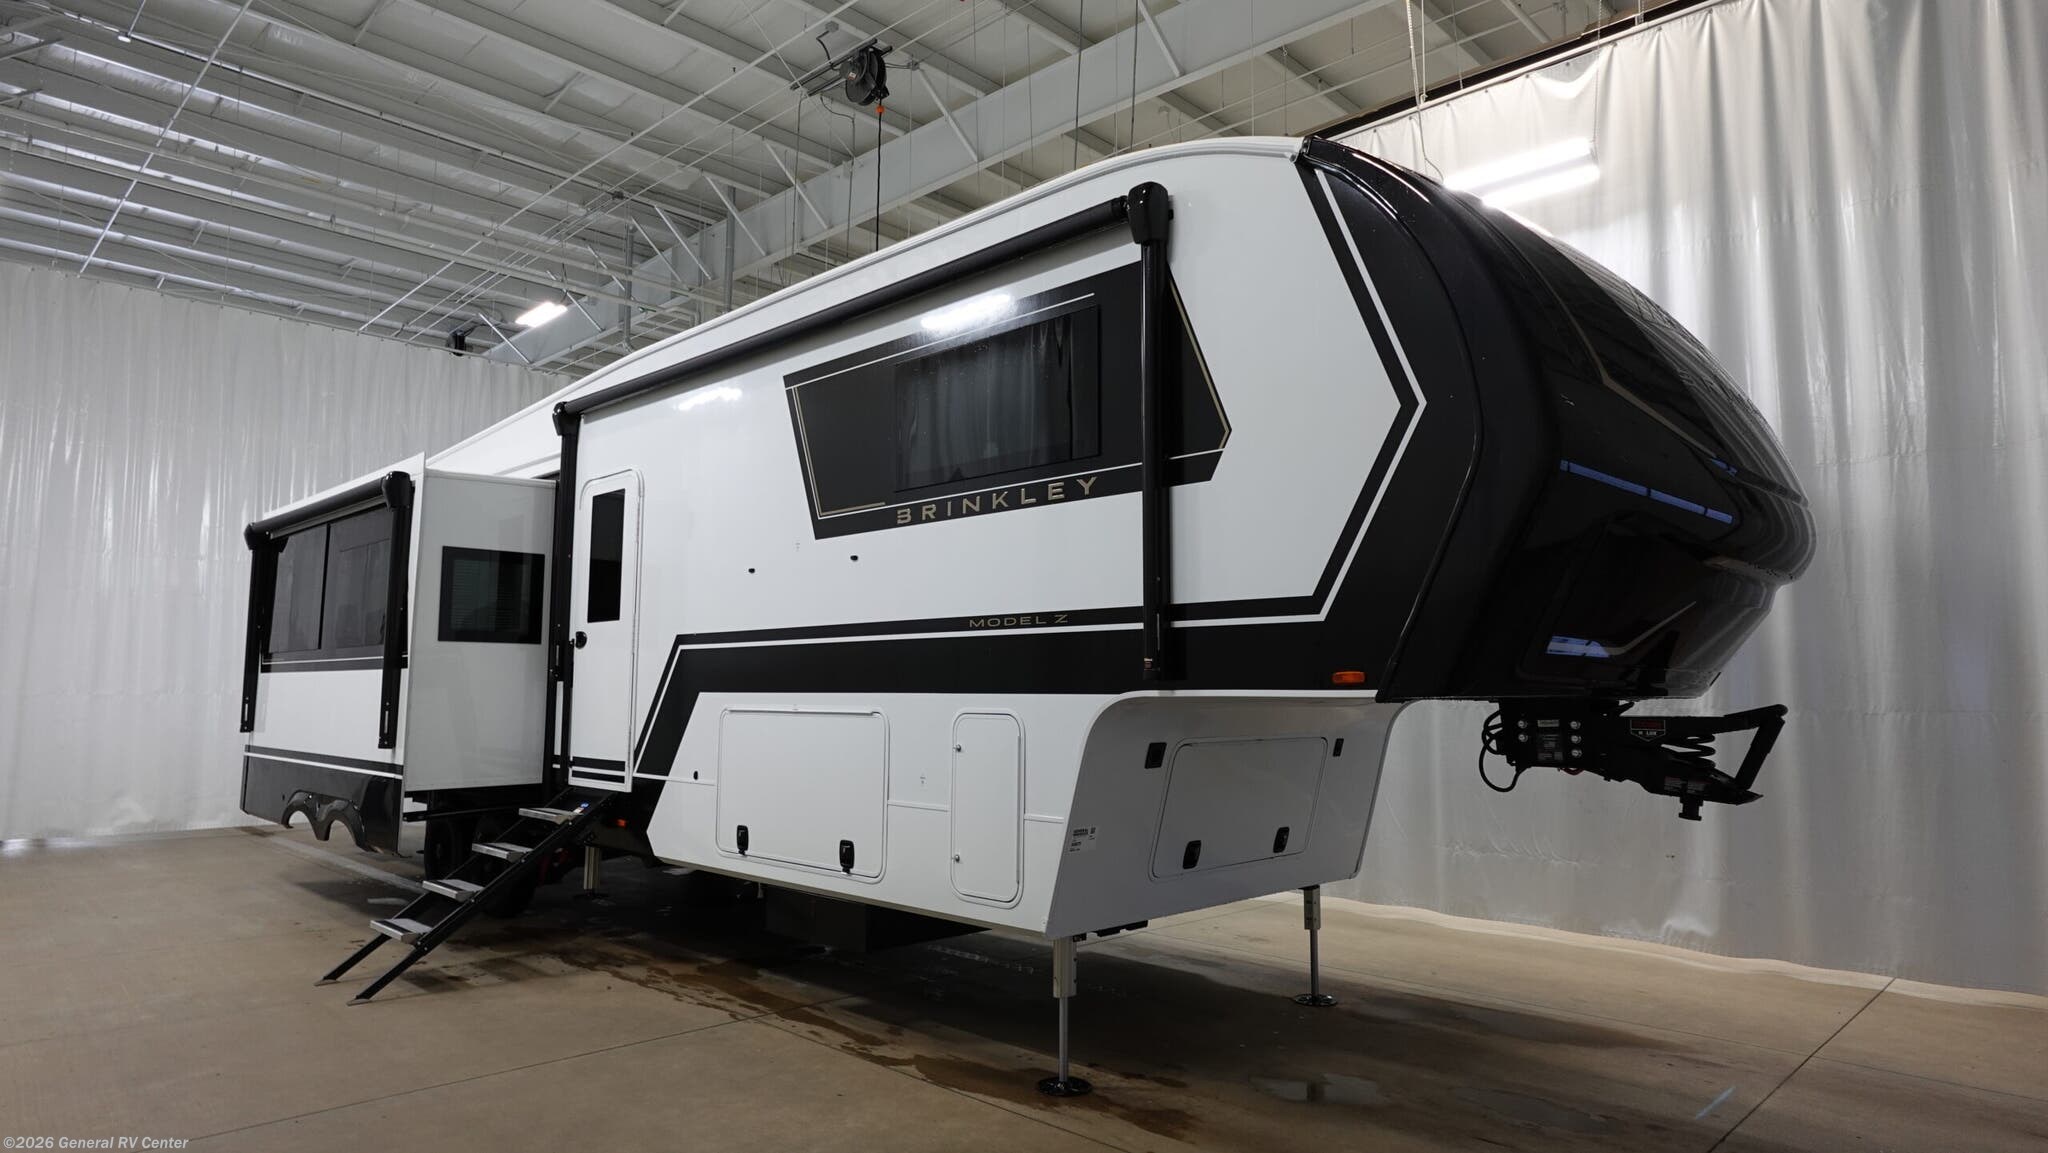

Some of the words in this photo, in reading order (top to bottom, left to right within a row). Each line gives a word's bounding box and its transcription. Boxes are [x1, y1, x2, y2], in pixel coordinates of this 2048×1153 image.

[896, 476, 1097, 524] BRINKLEY
[969, 616, 1047, 628] MODEL
[1054, 614, 1068, 624] Z
